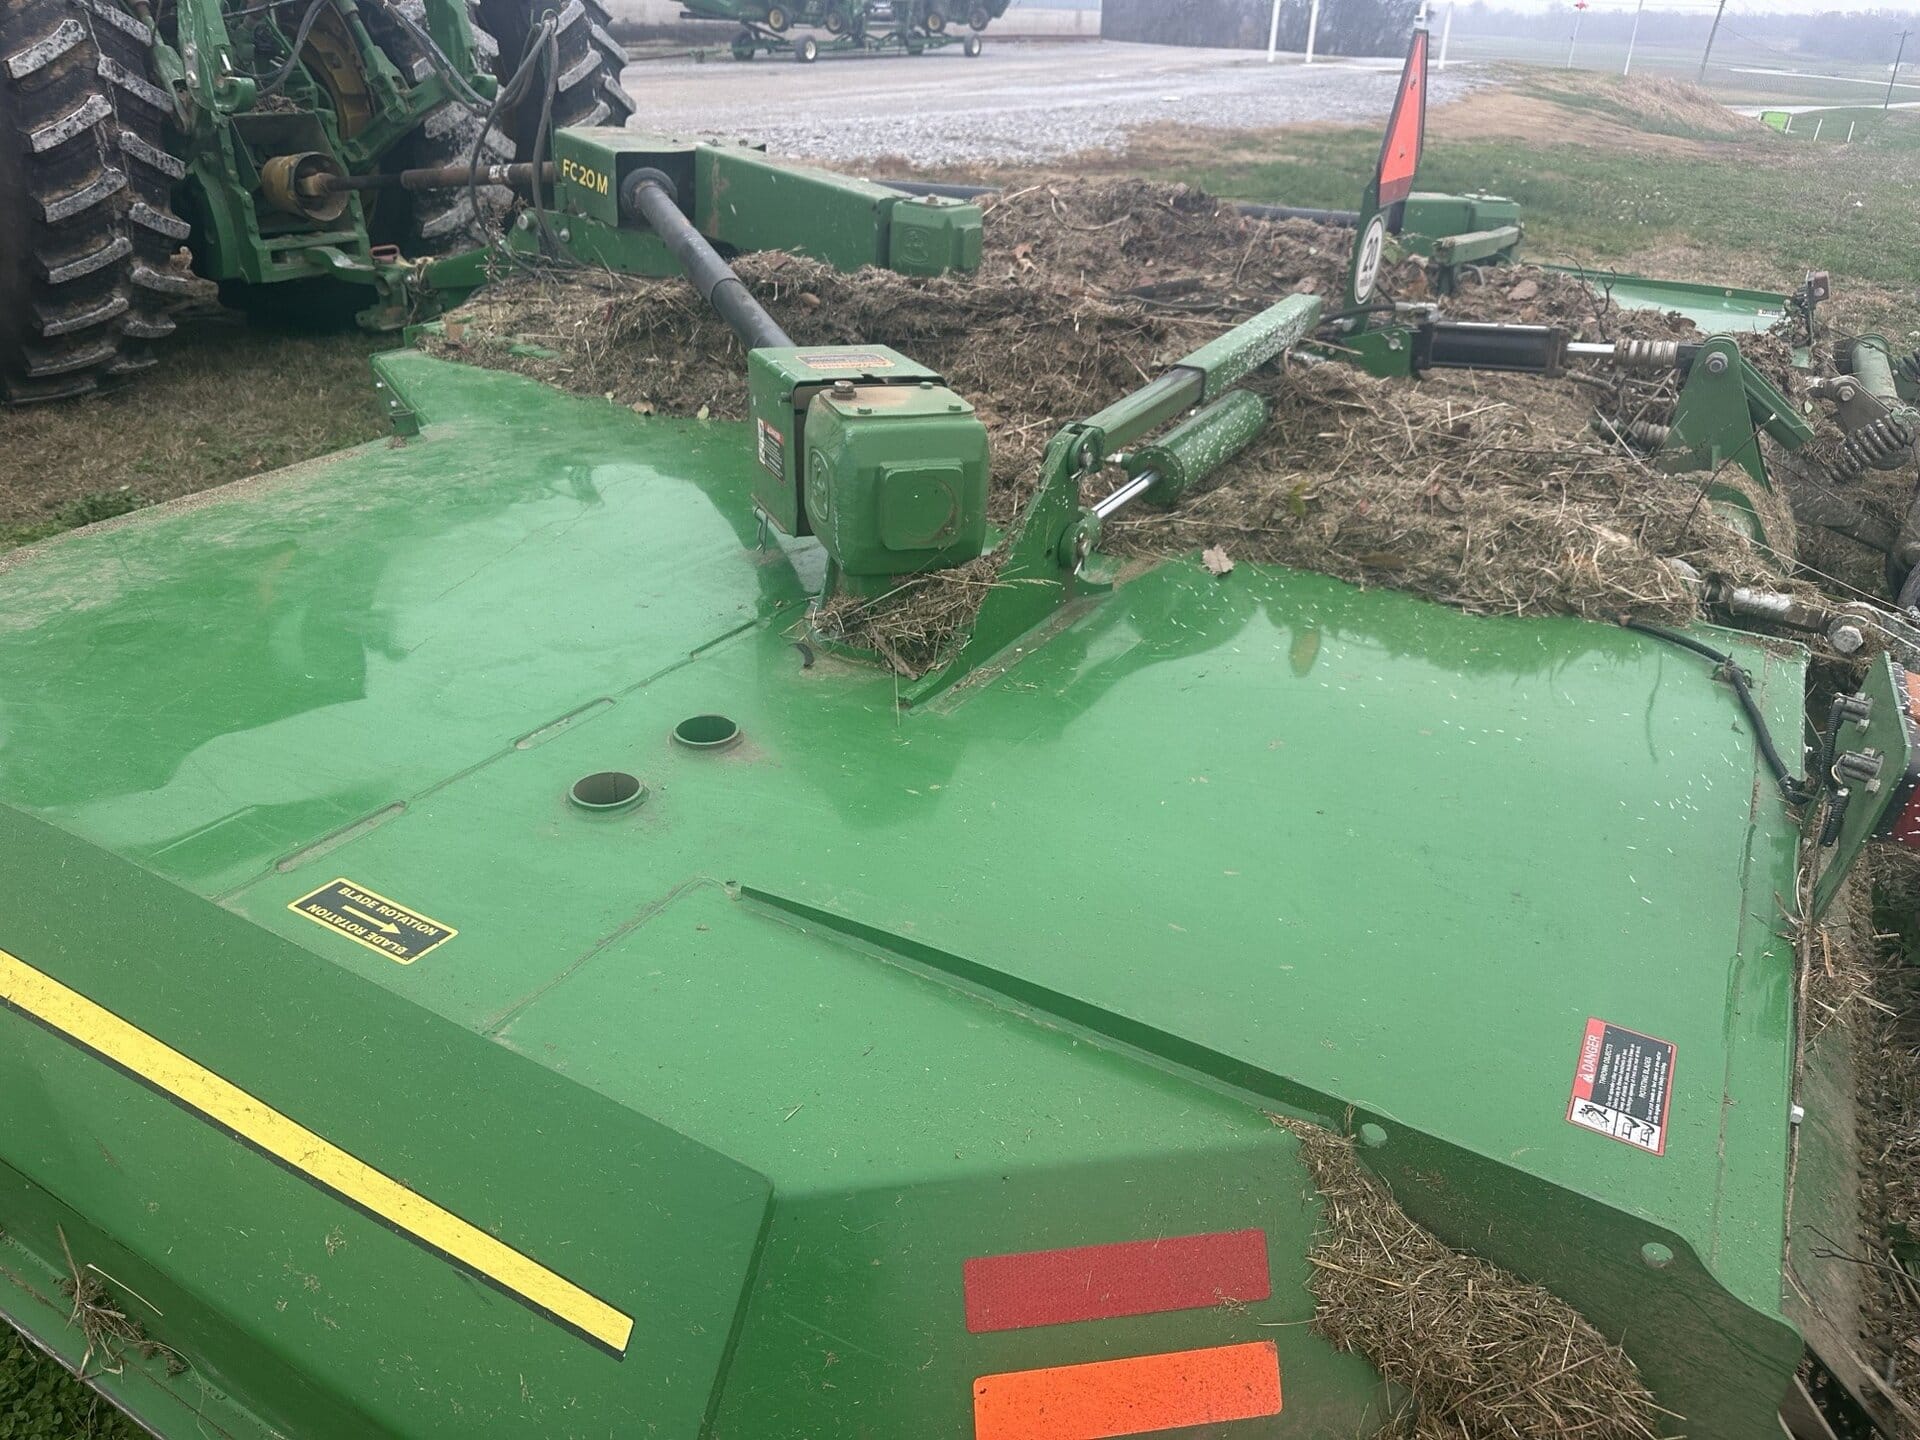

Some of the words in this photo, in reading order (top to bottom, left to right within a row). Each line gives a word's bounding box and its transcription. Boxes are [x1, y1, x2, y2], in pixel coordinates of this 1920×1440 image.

[562, 158, 608, 196] FC20M
[1363, 236, 1379, 272] 20
[306, 903, 368, 935] ROTATION
[337, 886, 379, 909] BLADE
[375, 904, 439, 936] ROTATION
[365, 931, 409, 955] BLADE
[1581, 1034, 1600, 1072] DANGER
[1642, 1056, 1651, 1074] BLADES
[1639, 1074, 1649, 1098] ROTATING
